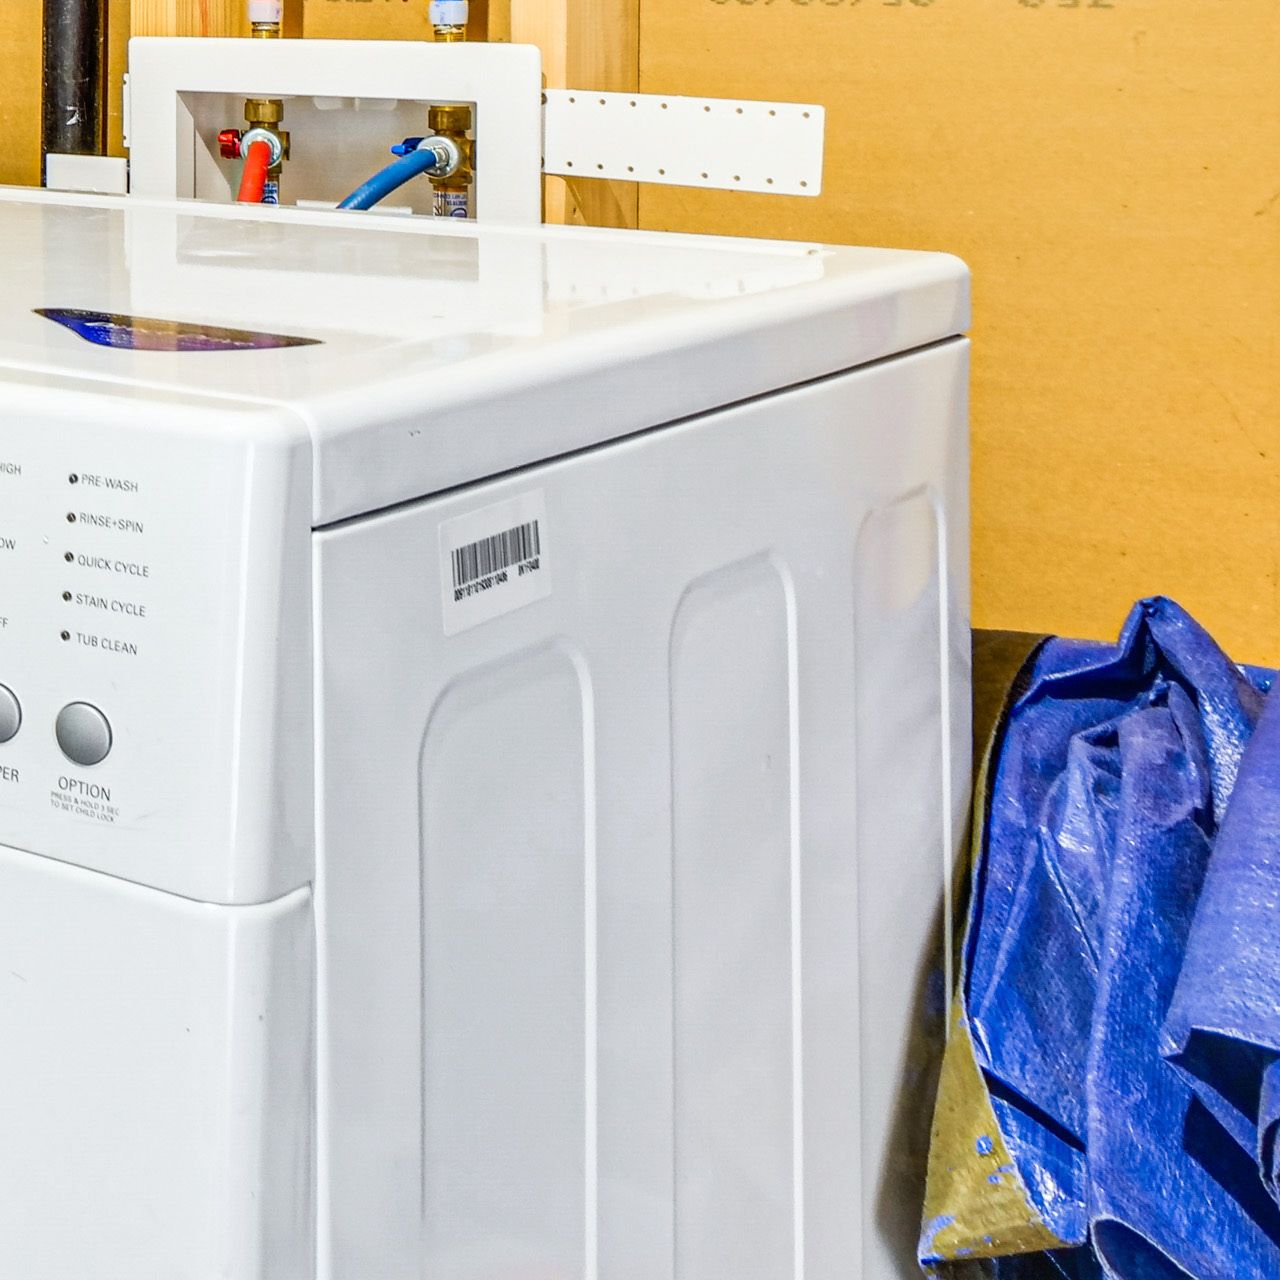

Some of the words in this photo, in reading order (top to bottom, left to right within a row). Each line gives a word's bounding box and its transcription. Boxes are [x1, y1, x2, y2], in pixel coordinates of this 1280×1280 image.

[81, 473, 139, 493] PRE-WASH
[79, 512, 144, 533] RINSE+SPIN
[77, 554, 112, 571] QUICK
[114, 561, 150, 578] CYCLE
[76, 593, 108, 610] STAIN
[111, 600, 146, 618] CYCLE
[76, 632, 98, 648] TUB
[101, 638, 138, 656] CLEAN
[57, 775, 111, 802] OPTION
[50, 790, 72, 803] PRESS
[80, 798, 100, 810] HOLD
[50, 798, 60, 808] TO
[61, 801, 74, 811] SET
[75, 805, 96, 818] CHILD
